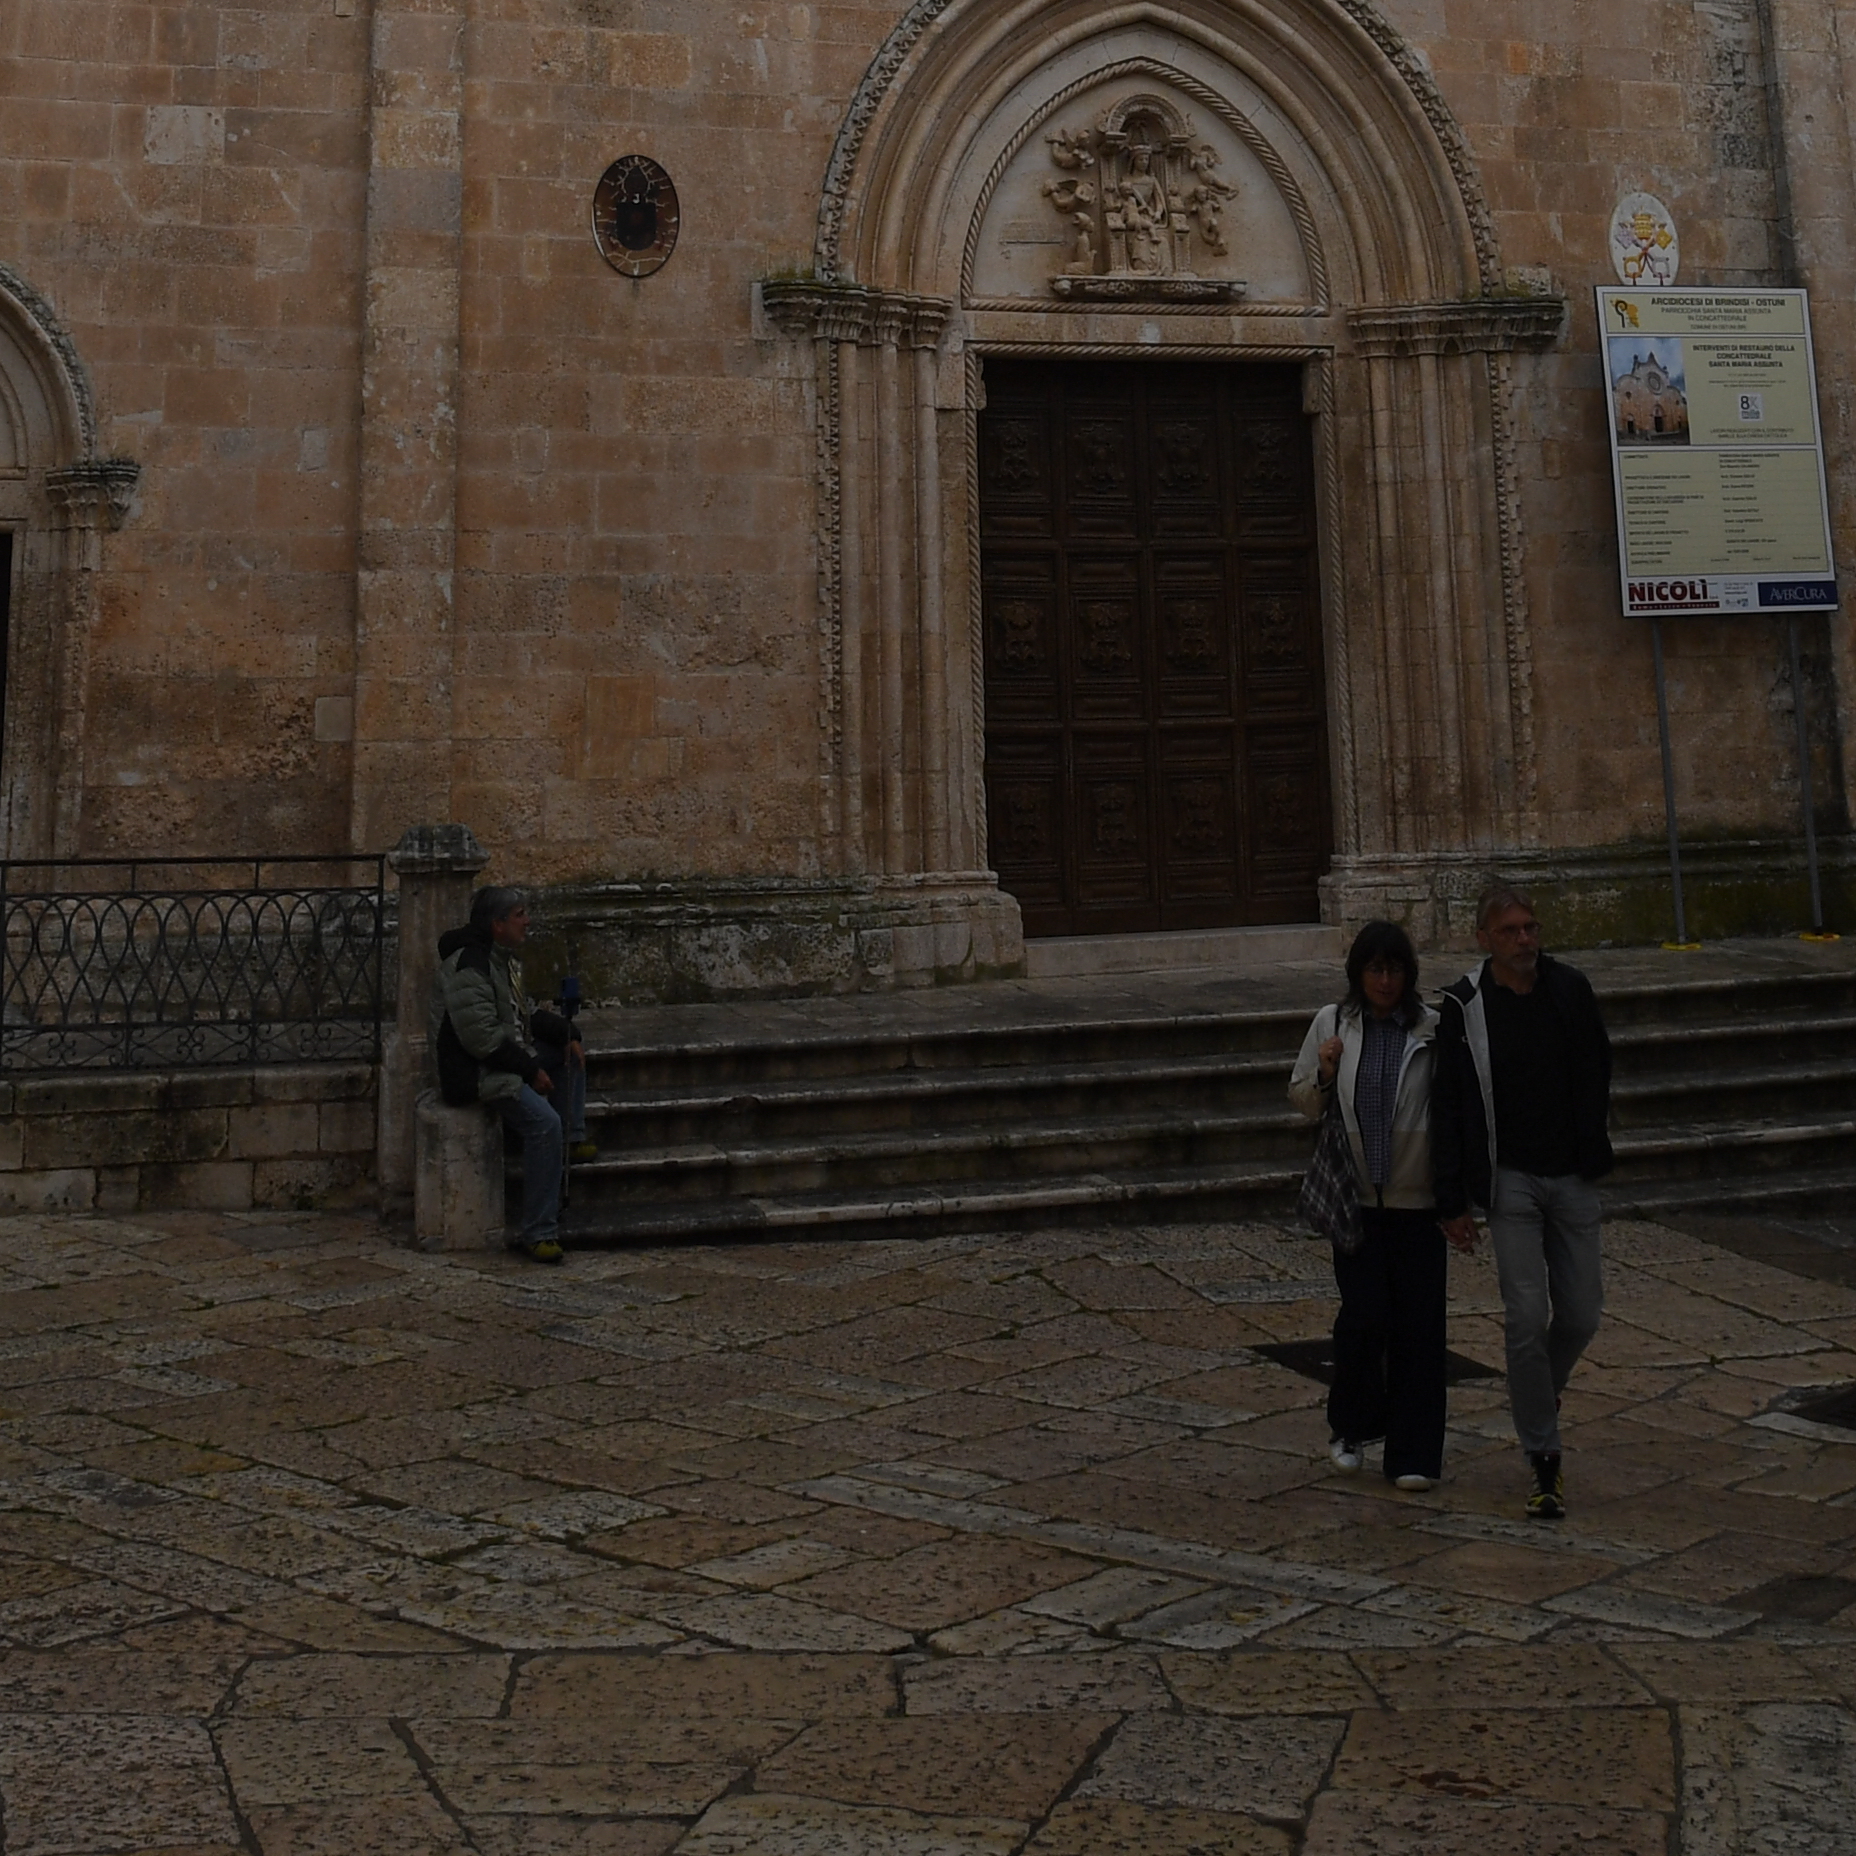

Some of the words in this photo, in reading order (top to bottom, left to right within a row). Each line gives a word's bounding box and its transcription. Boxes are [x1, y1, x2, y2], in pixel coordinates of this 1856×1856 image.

[1651, 297, 1703, 306] ARCIDIOCESI
[1705, 298, 1713, 306] DI
[1715, 298, 1749, 306] BRINDISI
[1756, 298, 1785, 306] OSTUNI
[1628, 579, 1708, 602] NICOLÌ
